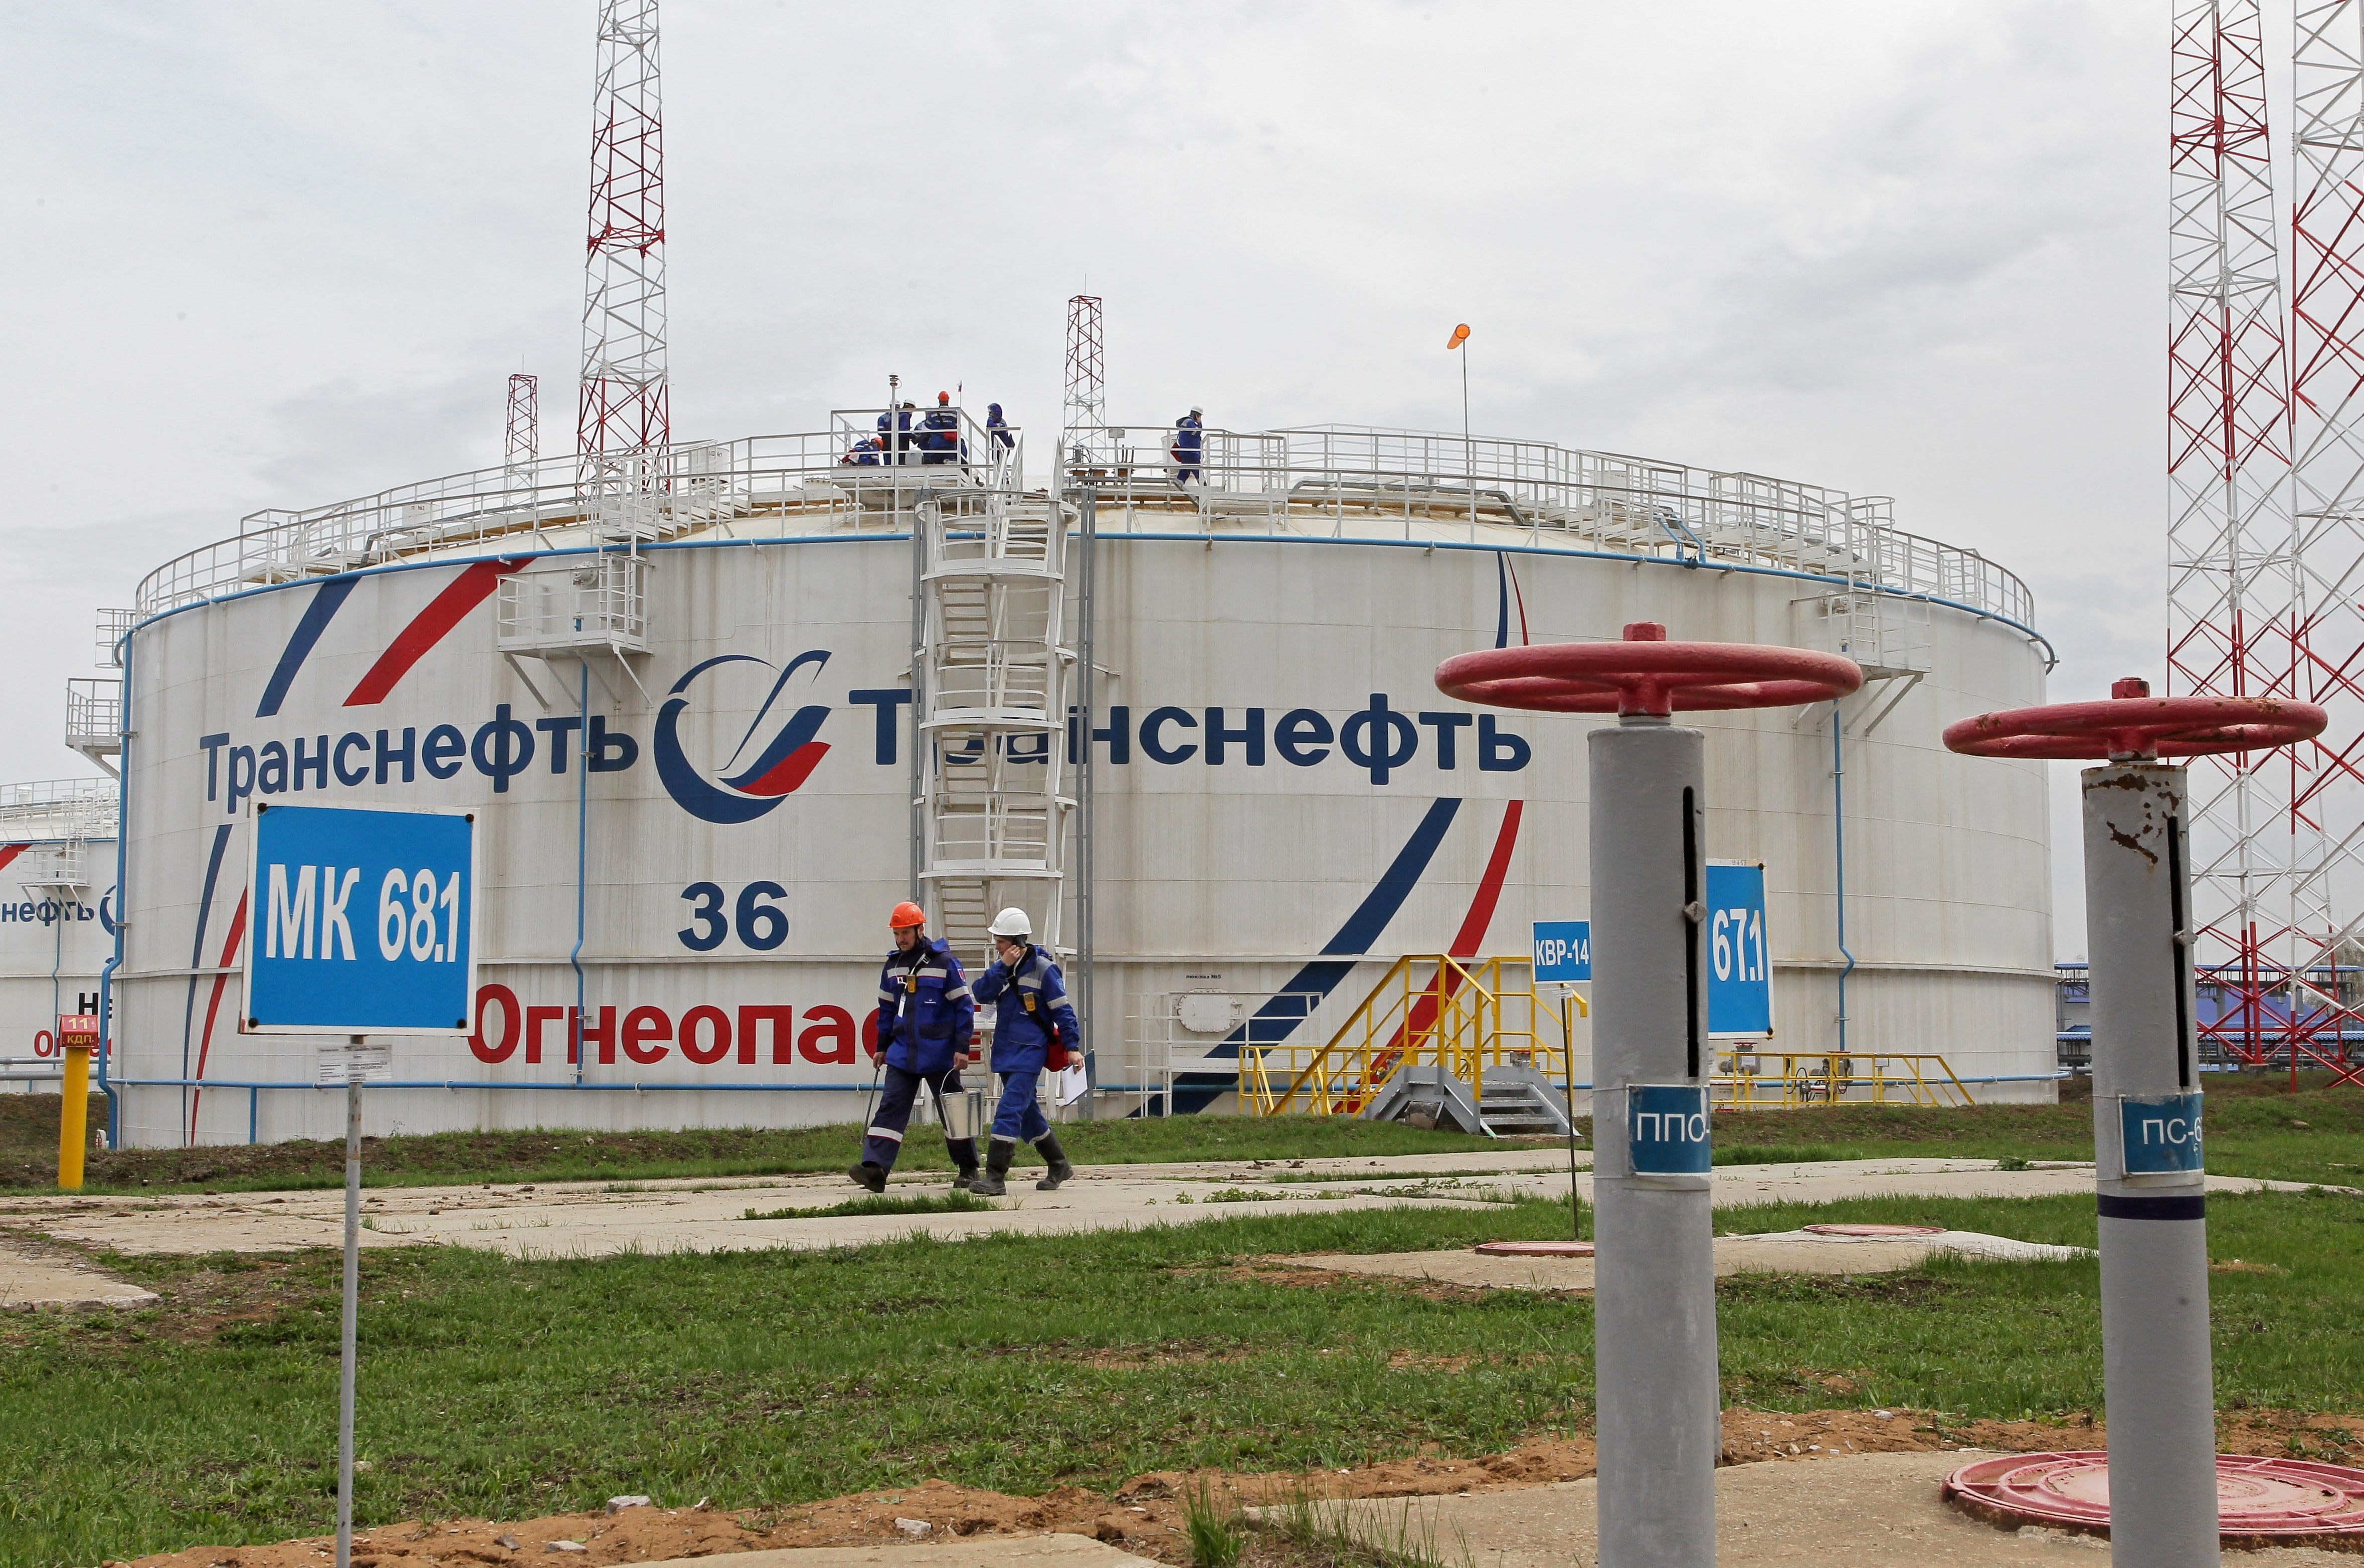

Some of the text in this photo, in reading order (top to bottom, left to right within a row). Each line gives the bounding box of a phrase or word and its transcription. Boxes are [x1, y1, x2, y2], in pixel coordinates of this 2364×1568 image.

[200, 704, 639, 814] Транснефть
[0, 896, 95, 926] нефть
[266, 864, 460, 963] МК 68.1
[677, 881, 789, 951] 36
[1536, 938, 1589, 966] КВР-14
[1712, 908, 1764, 982] 67.1
[67, 1035, 92, 1045] КДП
[68, 1018, 88, 1030] 11
[467, 983, 981, 1065] Огнеопа
[2142, 1116, 2203, 1144] ПС-6
